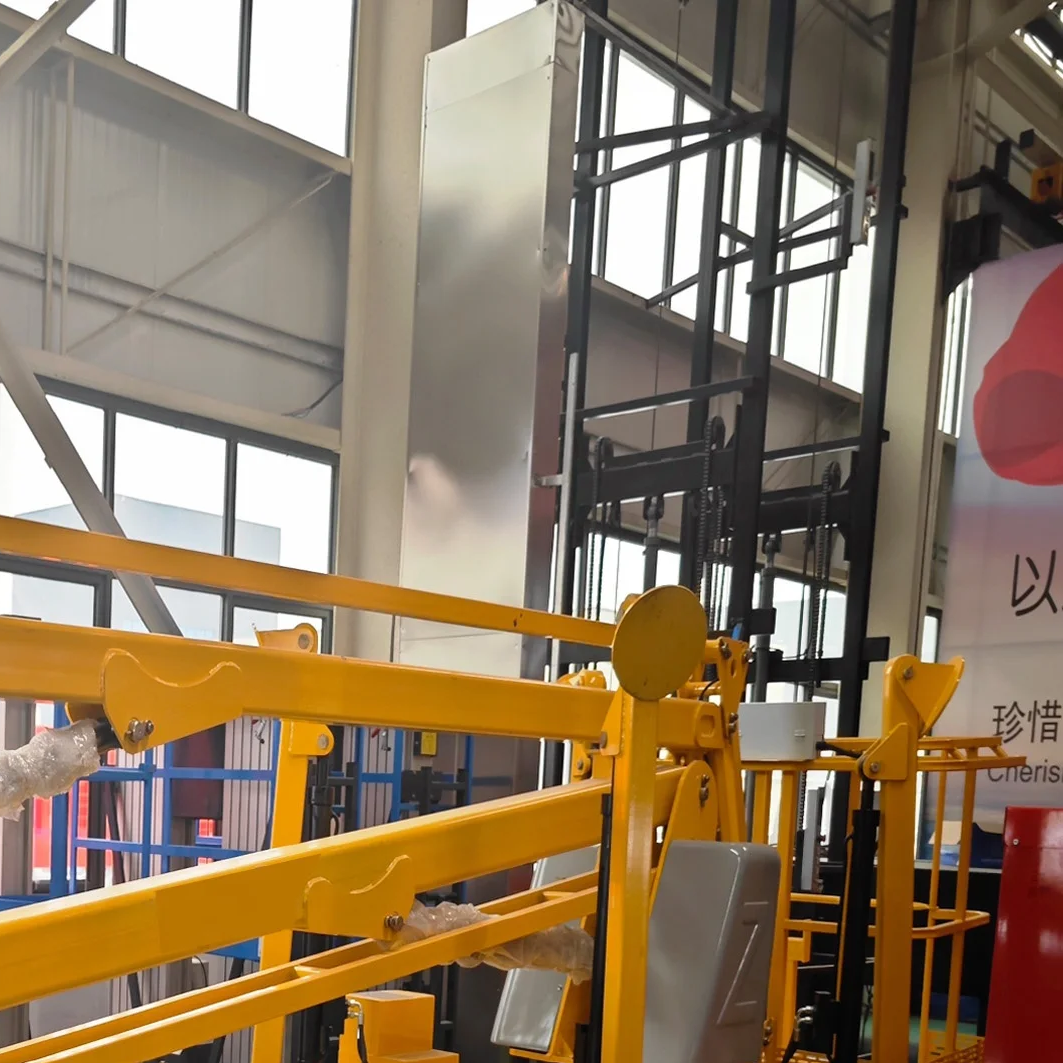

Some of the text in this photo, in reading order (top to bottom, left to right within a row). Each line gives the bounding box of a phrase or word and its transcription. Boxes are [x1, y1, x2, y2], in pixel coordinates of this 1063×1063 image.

[1011, 550, 1063, 617] 以
[992, 700, 1062, 744] 珍惜
[987, 758, 1063, 783] Cheris
